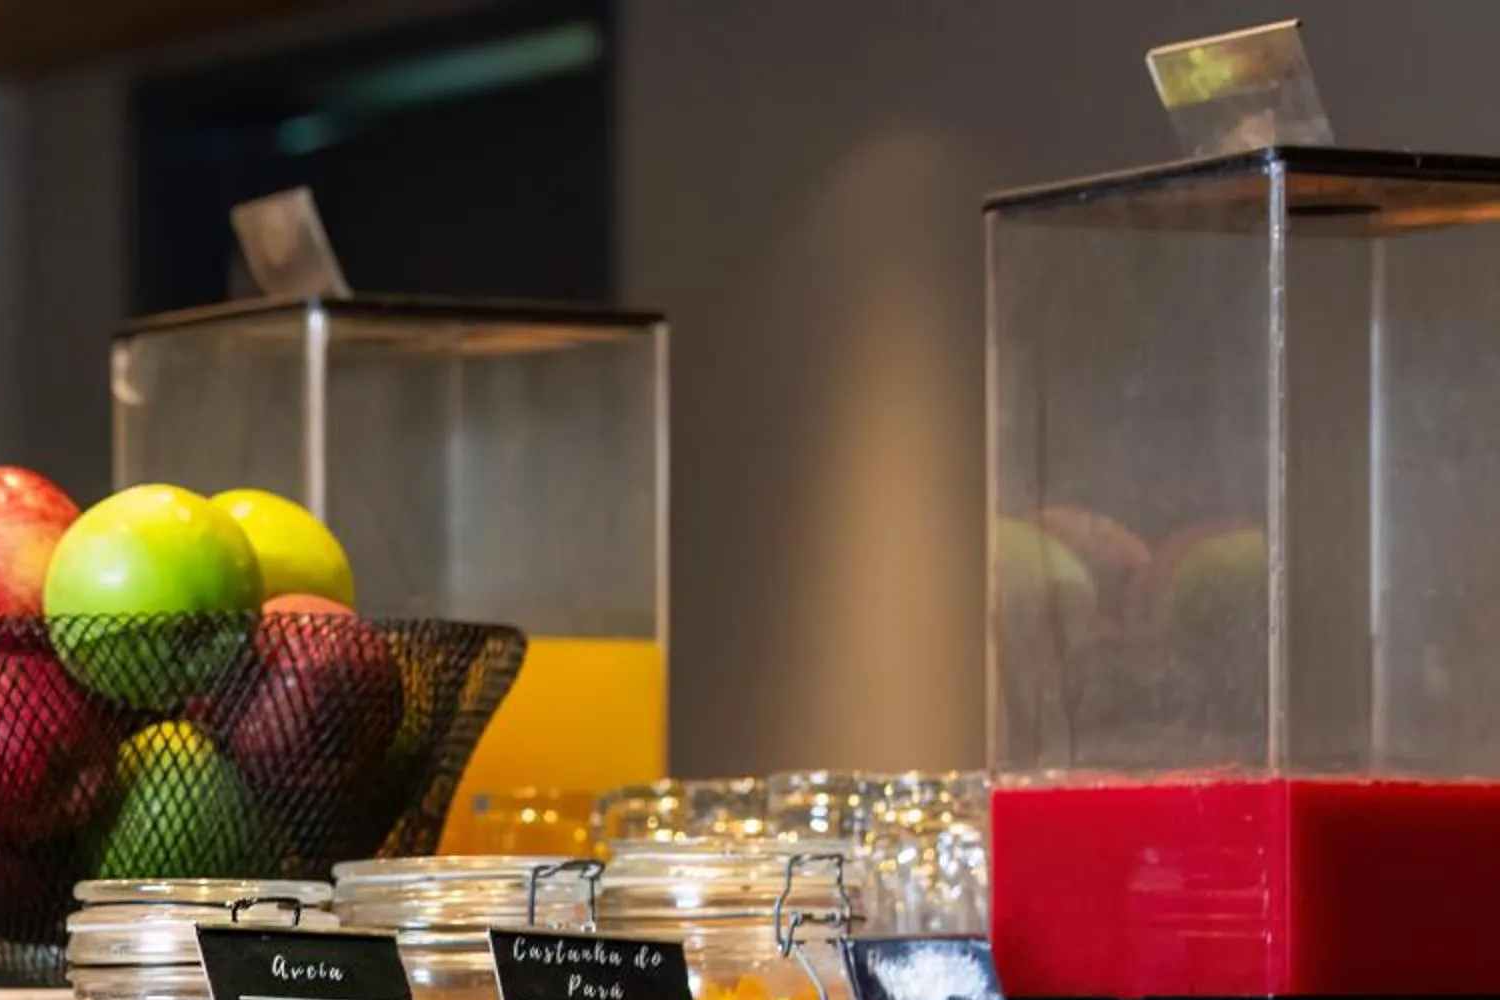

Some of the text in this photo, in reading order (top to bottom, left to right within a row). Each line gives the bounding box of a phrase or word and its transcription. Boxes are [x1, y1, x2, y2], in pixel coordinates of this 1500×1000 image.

[513, 936, 664, 970] Castanha do
[271, 954, 344, 981] Aveia
[567, 973, 625, 1000] Pará
